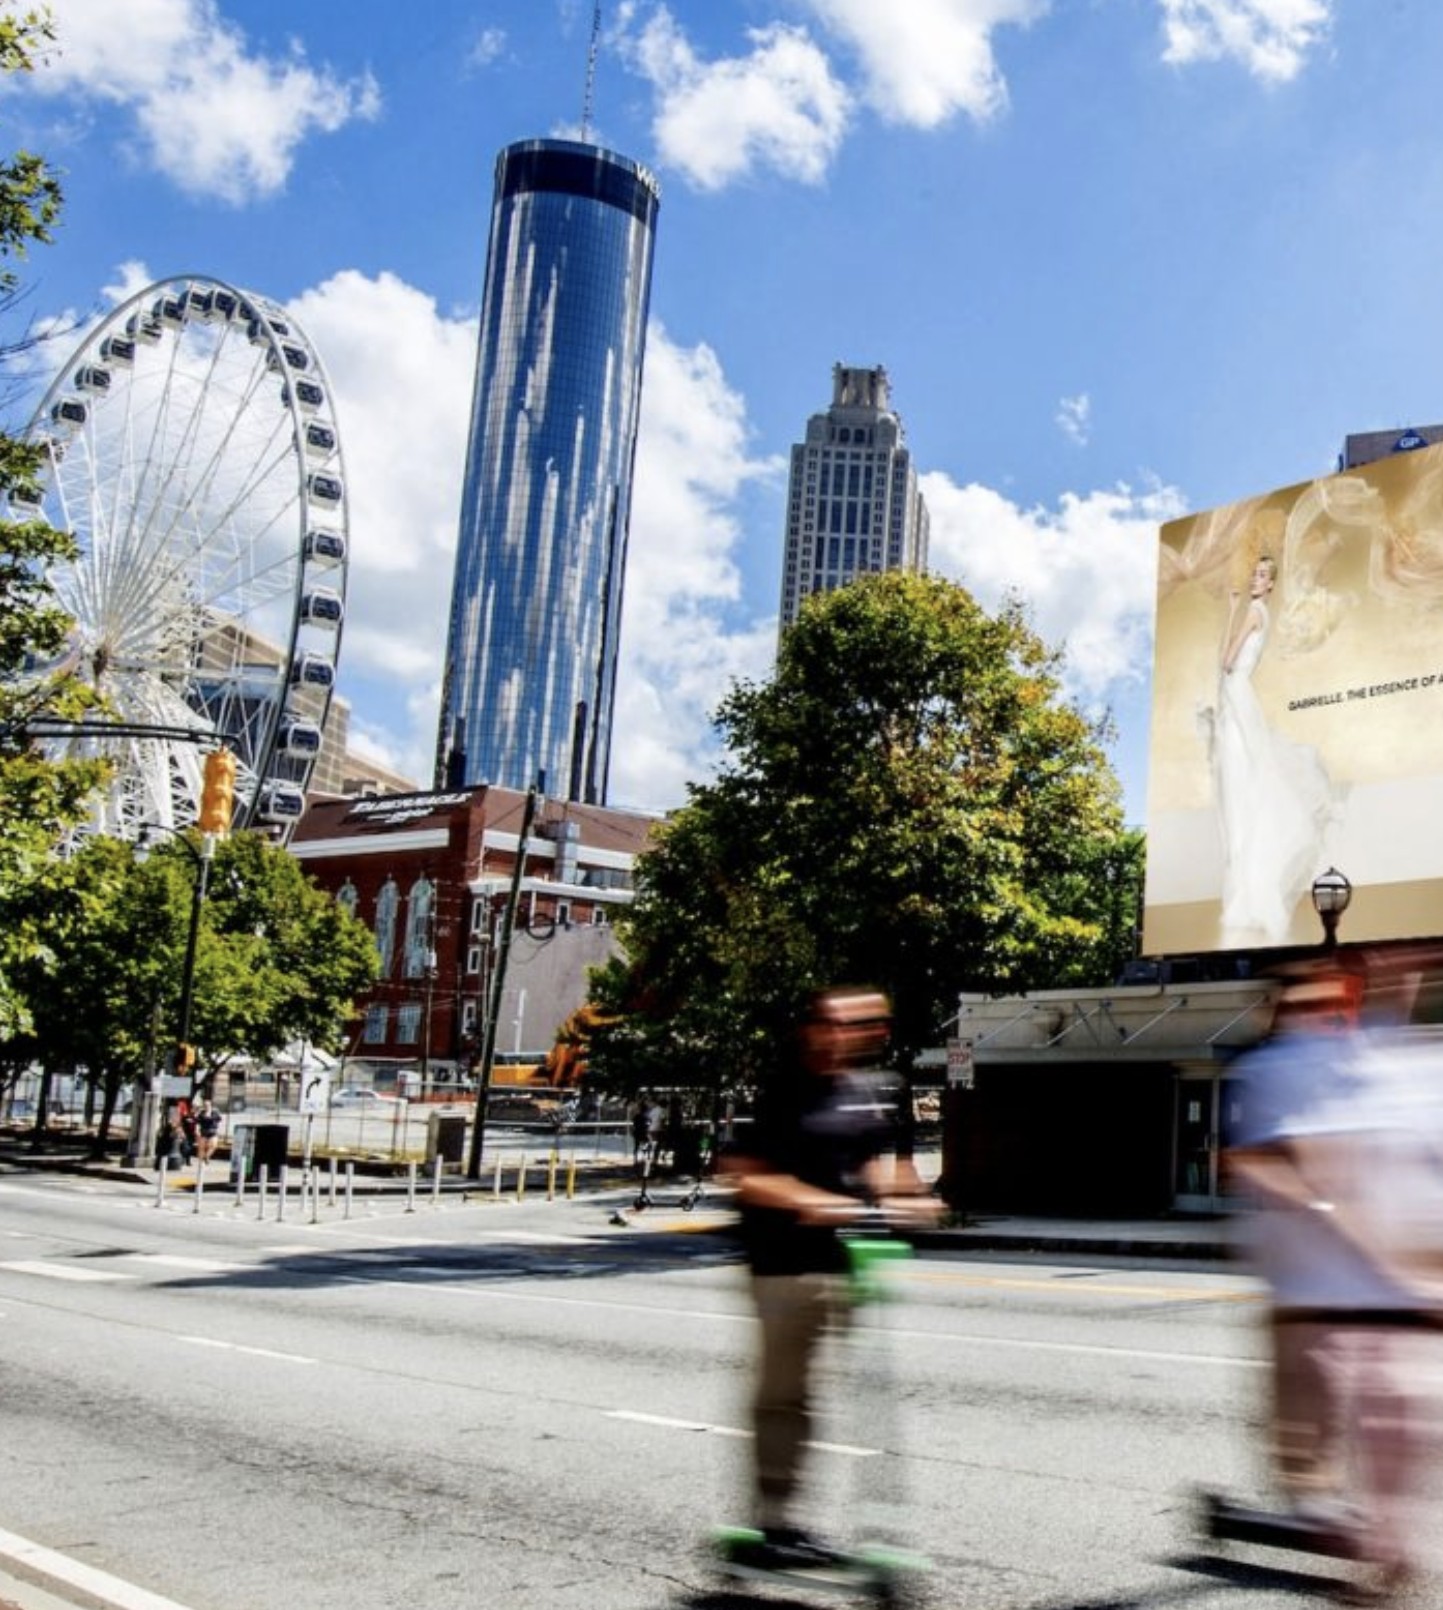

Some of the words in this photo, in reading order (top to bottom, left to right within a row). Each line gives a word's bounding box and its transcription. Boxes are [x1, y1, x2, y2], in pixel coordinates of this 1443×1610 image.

[1347, 687, 1366, 699] THE
[1369, 678, 1419, 697] ESSENCE
[1421, 675, 1436, 687] OF
